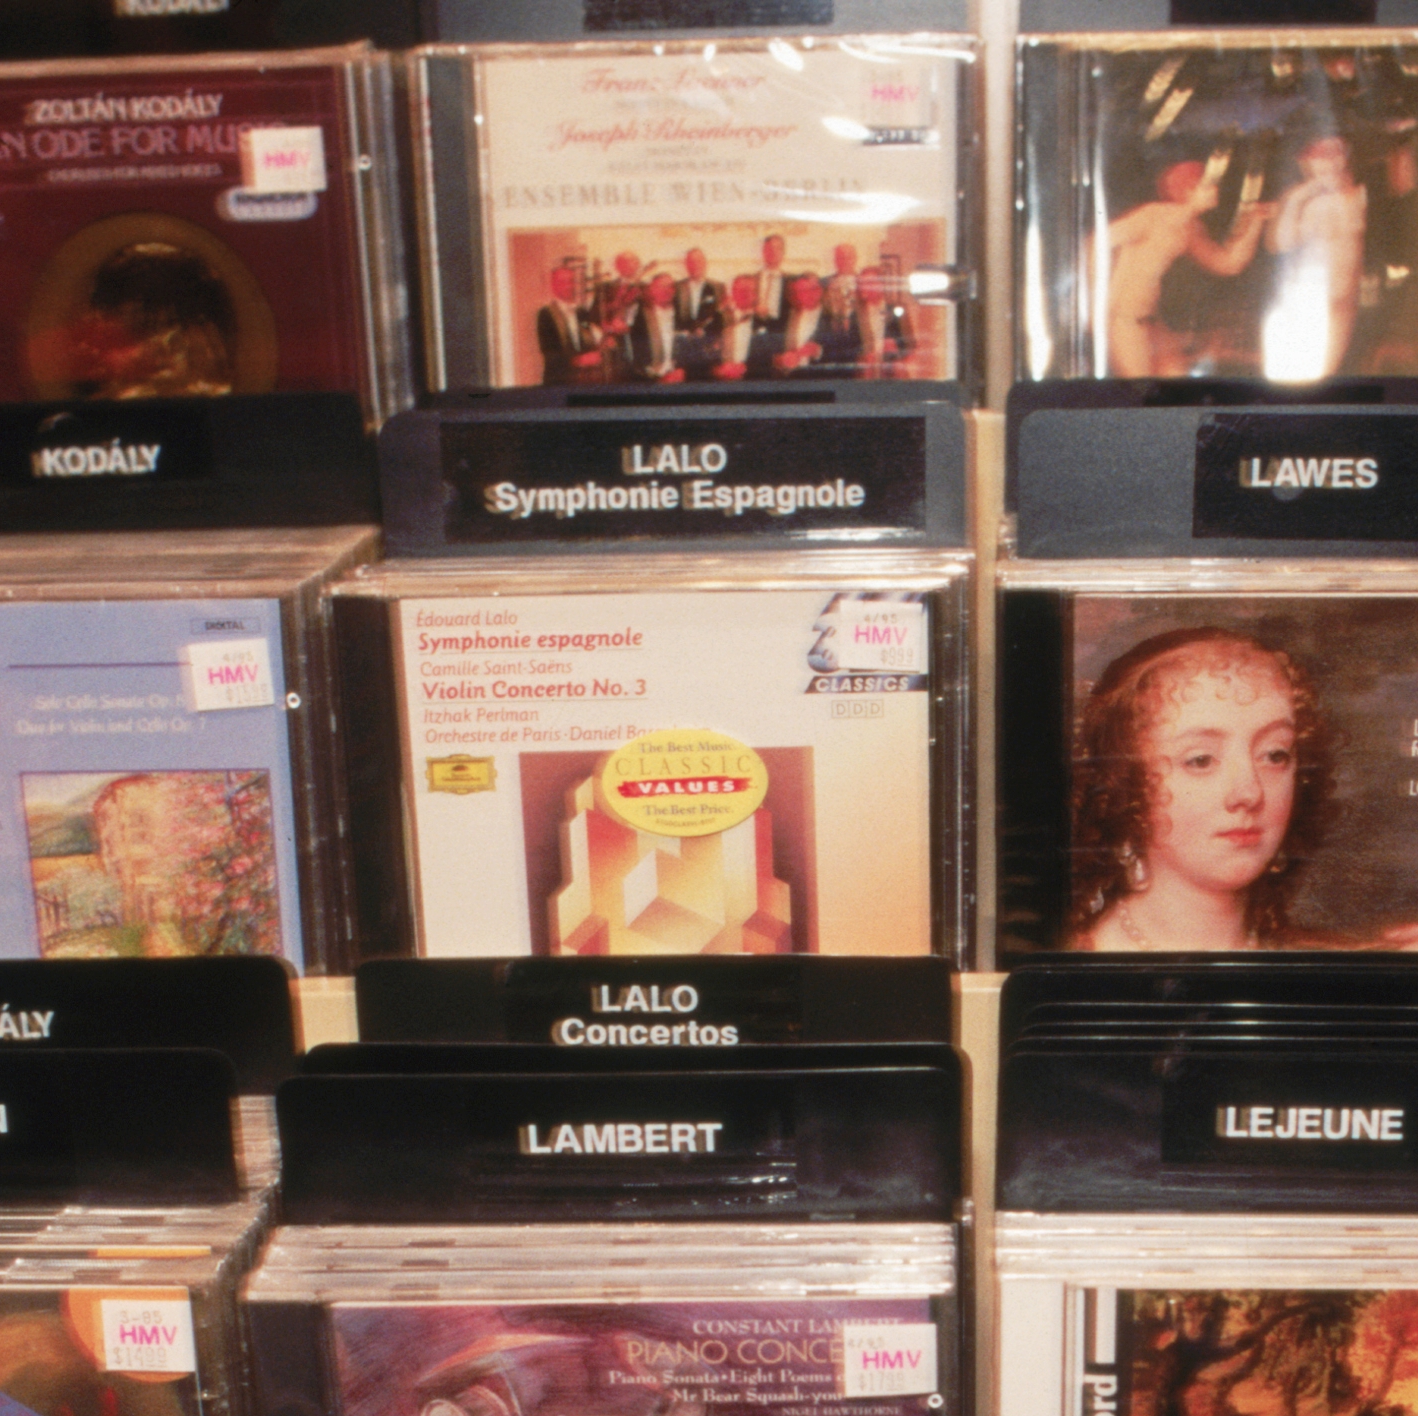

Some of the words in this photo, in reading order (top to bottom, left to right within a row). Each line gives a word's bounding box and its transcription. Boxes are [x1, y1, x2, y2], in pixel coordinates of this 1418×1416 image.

[30, 92, 125, 124] ZOLTÁN
[130, 88, 223, 120] KODÁLY
[40, 445, 161, 476] KODÁLY
[629, 445, 727, 474] LALO
[1251, 458, 1379, 488] LAWES
[494, 482, 679, 519] Symphonie
[692, 480, 865, 514] Espagnole
[417, 610, 481, 627] Édouard
[486, 609, 518, 627] Lalo
[418, 631, 532, 654] Symphonie
[537, 629, 643, 652] espagnole
[855, 626, 908, 645] HMV
[208, 665, 260, 685] HMV
[420, 659, 479, 676] Camille
[483, 658, 572, 675] Saint-Saëns
[423, 681, 485, 702] Violin
[492, 680, 585, 700] Concerto
[592, 679, 629, 697] No.
[634, 679, 647, 697] 3
[814, 677, 909, 692] CLASSICS
[615, 757, 752, 776] CLASSIC
[638, 781, 735, 795] VALUES
[601, 985, 698, 1012] LALO
[561, 1018, 738, 1046] Concertos
[1227, 1108, 1403, 1141] LEJEUNE
[529, 1124, 722, 1154] LAMBERT
[120, 1325, 178, 1346] HMV
[862, 1350, 921, 1372] HMV
